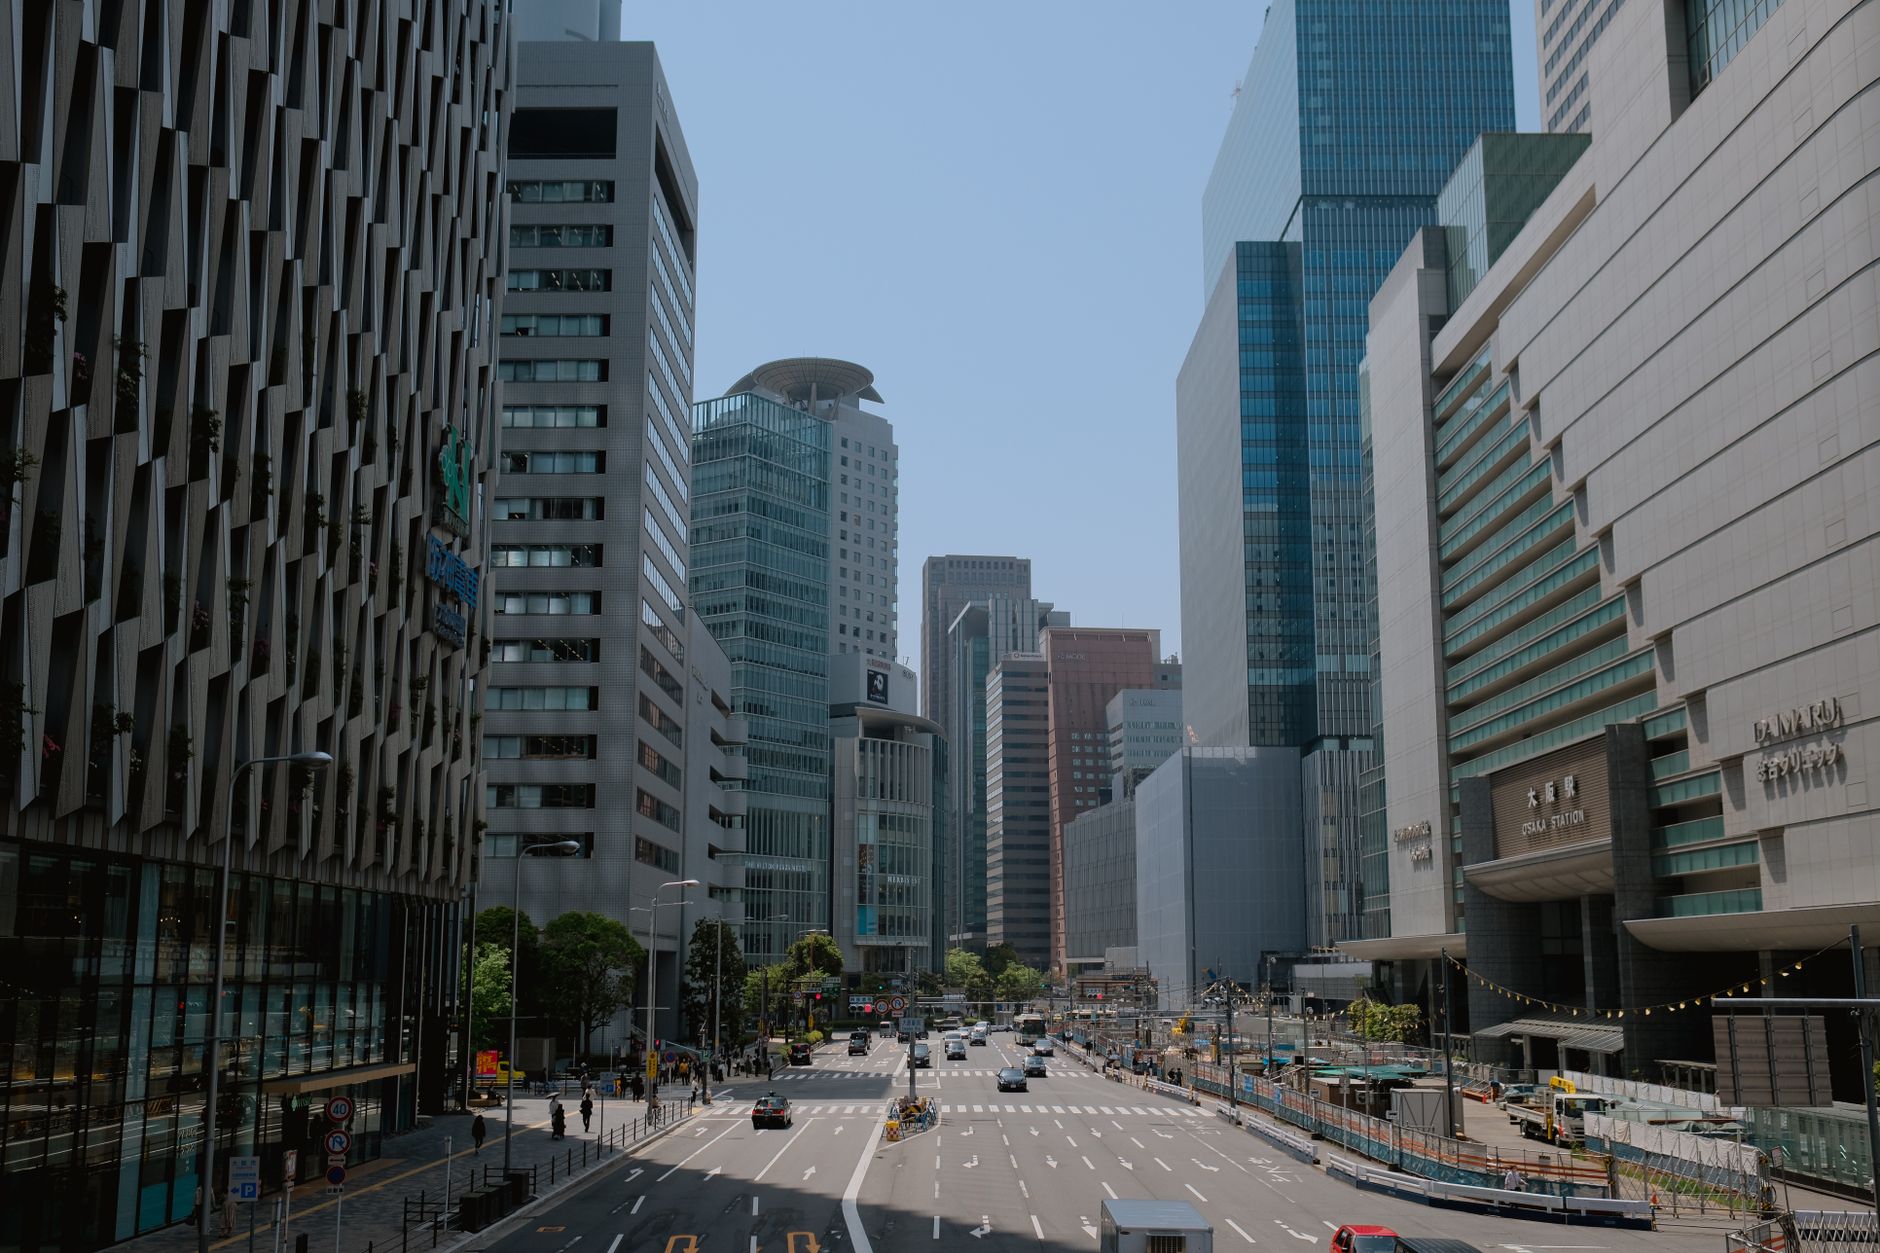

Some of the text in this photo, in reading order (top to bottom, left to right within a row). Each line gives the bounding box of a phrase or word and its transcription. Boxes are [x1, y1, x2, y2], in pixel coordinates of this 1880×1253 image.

[1753, 697, 1838, 742] DAIMARU
[1527, 775, 1576, 808] 大阪駅
[1522, 809, 1584, 835] OSAKA STATION
[333, 1103, 347, 1115] 40
[244, 1184, 253, 1197] P
